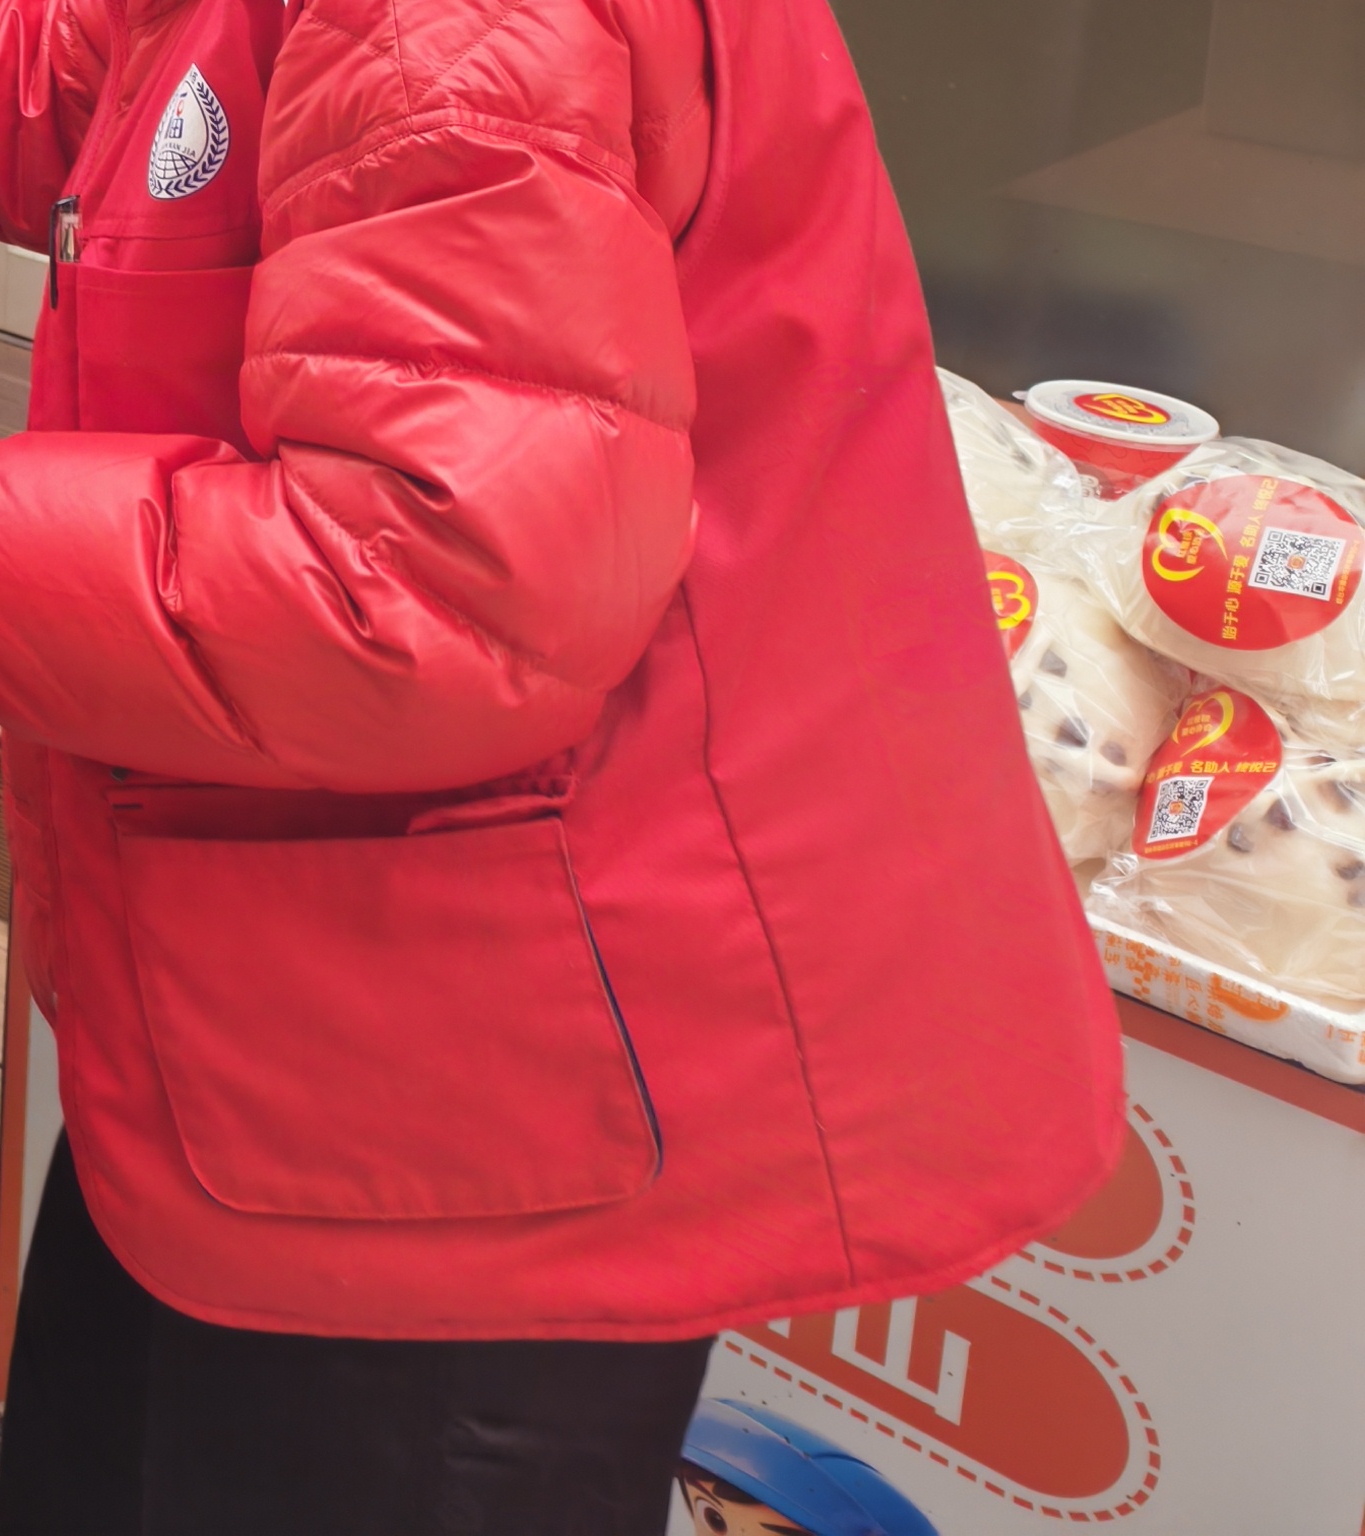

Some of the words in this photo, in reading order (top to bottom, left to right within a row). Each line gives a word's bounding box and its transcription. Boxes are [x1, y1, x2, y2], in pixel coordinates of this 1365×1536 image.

[1239, 509, 1264, 548] 名助人
[1226, 554, 1251, 595] 源于爱
[1221, 597, 1240, 641] 始于心
[1189, 759, 1231, 774] 名助人
[1234, 760, 1277, 774] 终悦己
